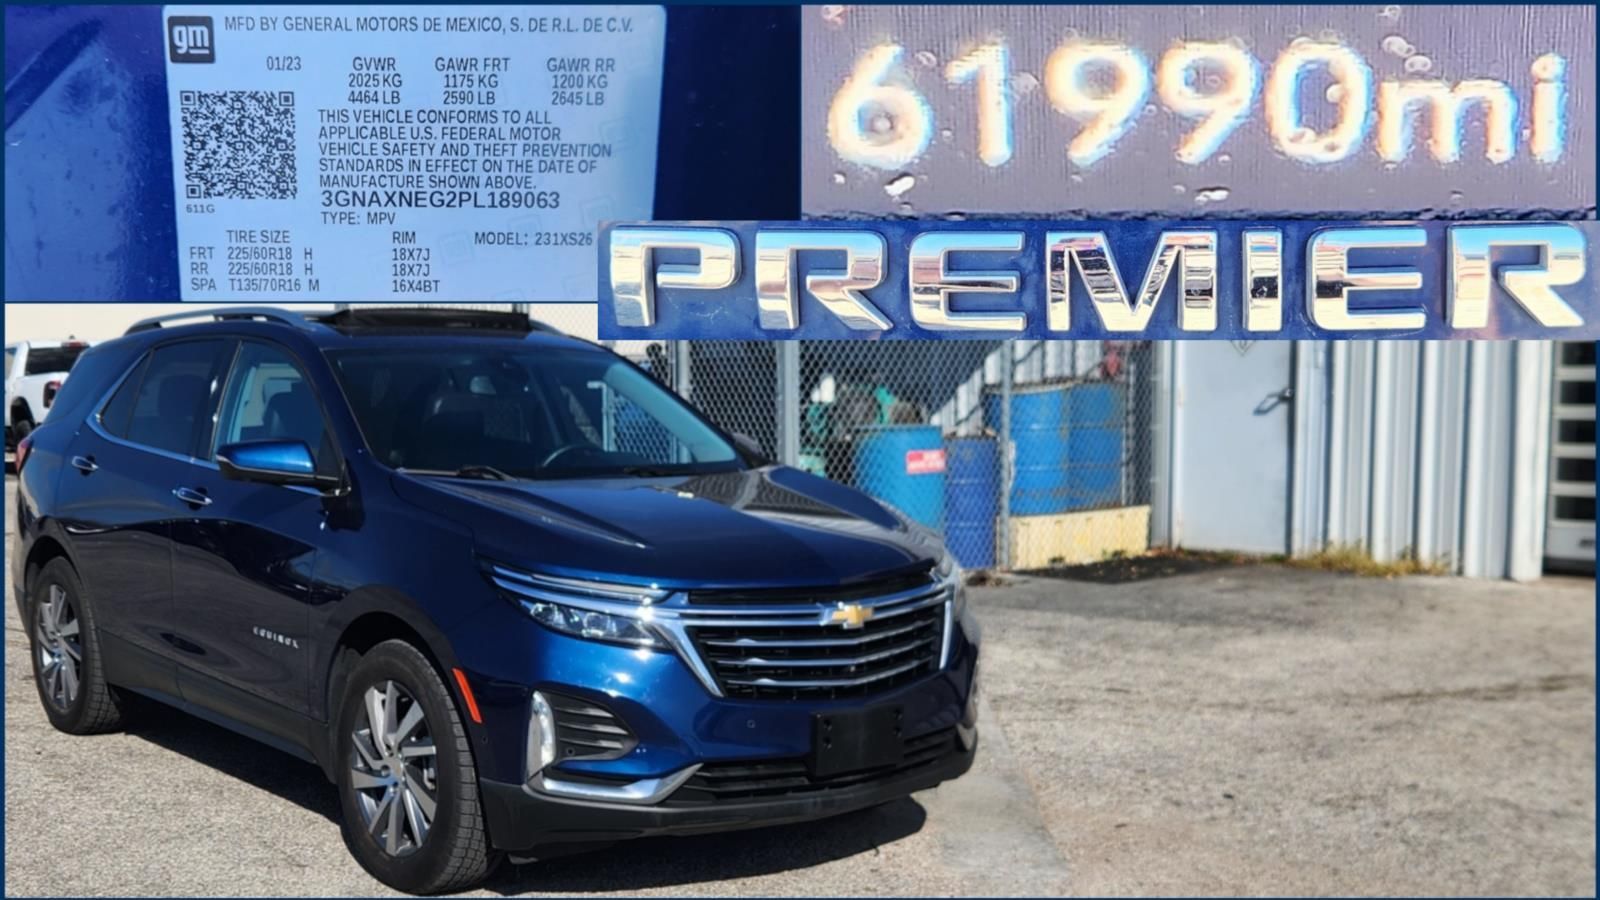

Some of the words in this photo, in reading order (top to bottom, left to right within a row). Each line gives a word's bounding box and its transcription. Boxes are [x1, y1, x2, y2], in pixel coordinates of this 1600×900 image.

[224, 16, 255, 31] MFD
[260, 16, 278, 31] BY
[283, 16, 352, 31] GENERAL
[356, 16, 418, 32] MOTORS
[423, 17, 441, 32] DE
[446, 17, 506, 34] MEXICO,
[510, 17, 523, 32] S.
[528, 17, 547, 32] DE
[552, 18, 579, 32] R.L.
[583, 18, 603, 32] DE
[606, 18, 633, 32] C.V.
[172, 25, 210, 54] gm
[266, 56, 302, 71] 01/23
[352, 57, 396, 71] GVWR
[435, 57, 478, 72] GAWR
[483, 57, 511, 72] FRT
[547, 58, 590, 72] GAWR
[595, 58, 615, 72] RR
[348, 73, 380, 88] 2025
[382, 73, 402, 88] KG
[444, 74, 474, 88] 1175
[478, 74, 498, 89] KG
[552, 74, 584, 89] 1200
[587, 74, 608, 89] KG
[348, 90, 379, 104] 4464
[382, 90, 401, 104] LB
[443, 90, 474, 105] 2590
[477, 90, 496, 105] LB
[551, 91, 583, 106] 2645
[586, 91, 605, 106] LB
[827, 41, 1567, 169] 61990mi
[318, 109, 349, 123] THIS
[353, 109, 413, 123] VEHICLE
[417, 110, 498, 124] CONFORMS
[502, 110, 521, 124] TO
[525, 110, 552, 124] ALL
[319, 126, 405, 140] APPLICABLE
[410, 126, 437, 140] U.S.
[441, 127, 505, 141] FEDERAL
[509, 127, 561, 141] MOTOR
[319, 142, 378, 156] VEHICLE
[382, 142, 436, 156] SAFETY
[440, 142, 470, 157] AND
[474, 143, 518, 157] THEFT
[522, 143, 612, 157] PREVENTION
[319, 158, 404, 172] STANDARDS
[408, 159, 422, 172] IN
[425, 159, 478, 172] EFFECT
[481, 159, 503, 173] ON
[507, 159, 534, 173] THE
[538, 159, 575, 173] DATE
[577, 159, 598, 173] OF
[319, 174, 425, 188] MANUFACTURE
[428, 174, 481, 189] SHOWN
[484, 175, 538, 189] ABOVE.
[321, 190, 561, 209] 3GNAXNEG2PL189063
[320, 211, 361, 225] TYPE:
[367, 211, 397, 225] MPV
[226, 230, 258, 244] TIRE
[260, 230, 291, 244] SIZE
[392, 231, 416, 244] RIM
[474, 232, 529, 246] MODEL:
[534, 232, 593, 246] 231XS26
[189, 246, 215, 260] FRT
[227, 247, 293, 261] 225/60R18
[304, 247, 313, 261] H
[392, 247, 431, 261] 18X7J
[190, 263, 209, 276] RR
[228, 263, 294, 277] 225/60R18
[304, 263, 313, 276] H
[392, 263, 431, 277] 18X7J
[190, 278, 217, 293] SPA
[228, 278, 302, 293] T135/70R16
[308, 279, 320, 292] M
[608, 225, 1589, 332] PREMIER
[392, 279, 440, 294] 16X4BT
